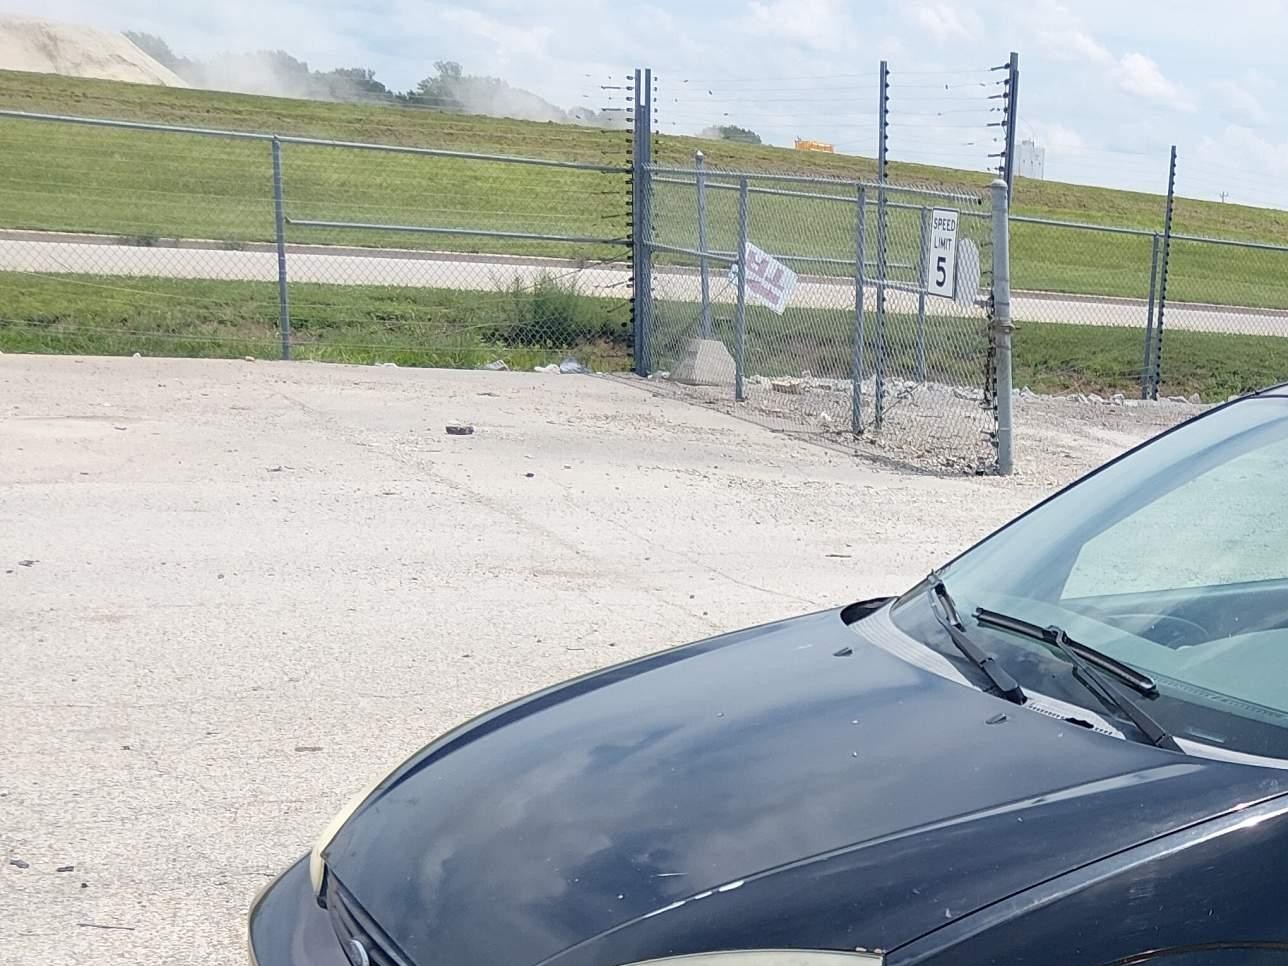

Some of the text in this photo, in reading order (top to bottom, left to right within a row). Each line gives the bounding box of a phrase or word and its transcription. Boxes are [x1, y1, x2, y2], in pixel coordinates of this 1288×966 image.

[933, 217, 956, 232] SPEED
[933, 236, 952, 252] LIMIT
[935, 255, 947, 287] 5
